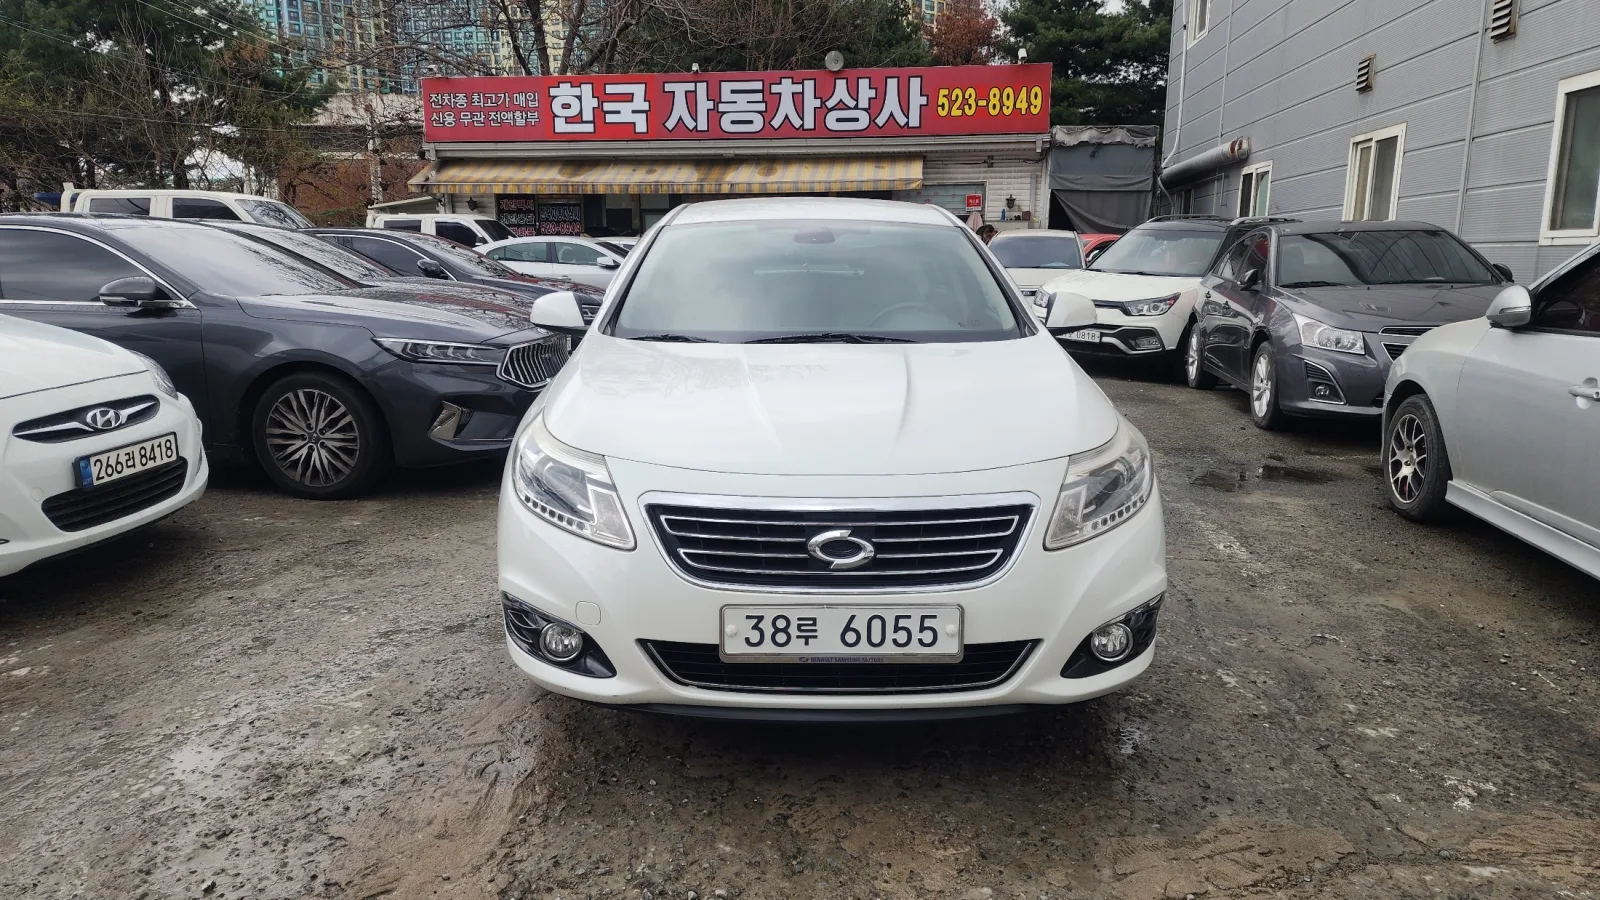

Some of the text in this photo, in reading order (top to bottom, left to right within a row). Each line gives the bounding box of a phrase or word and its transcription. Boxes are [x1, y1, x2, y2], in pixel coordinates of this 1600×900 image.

[429, 92, 539, 108] 전차종 최고가 매입
[548, 76, 928, 134] 한국 자동차상사
[937, 84, 1043, 118] 523-8949
[430, 111, 540, 128] 신용 무관 전액할부
[540, 221, 582, 235] 523-8949
[1076, 331, 1096, 341] 0818
[94, 439, 173, 481] 266러 8418
[744, 614, 938, 648] 38루 6055
